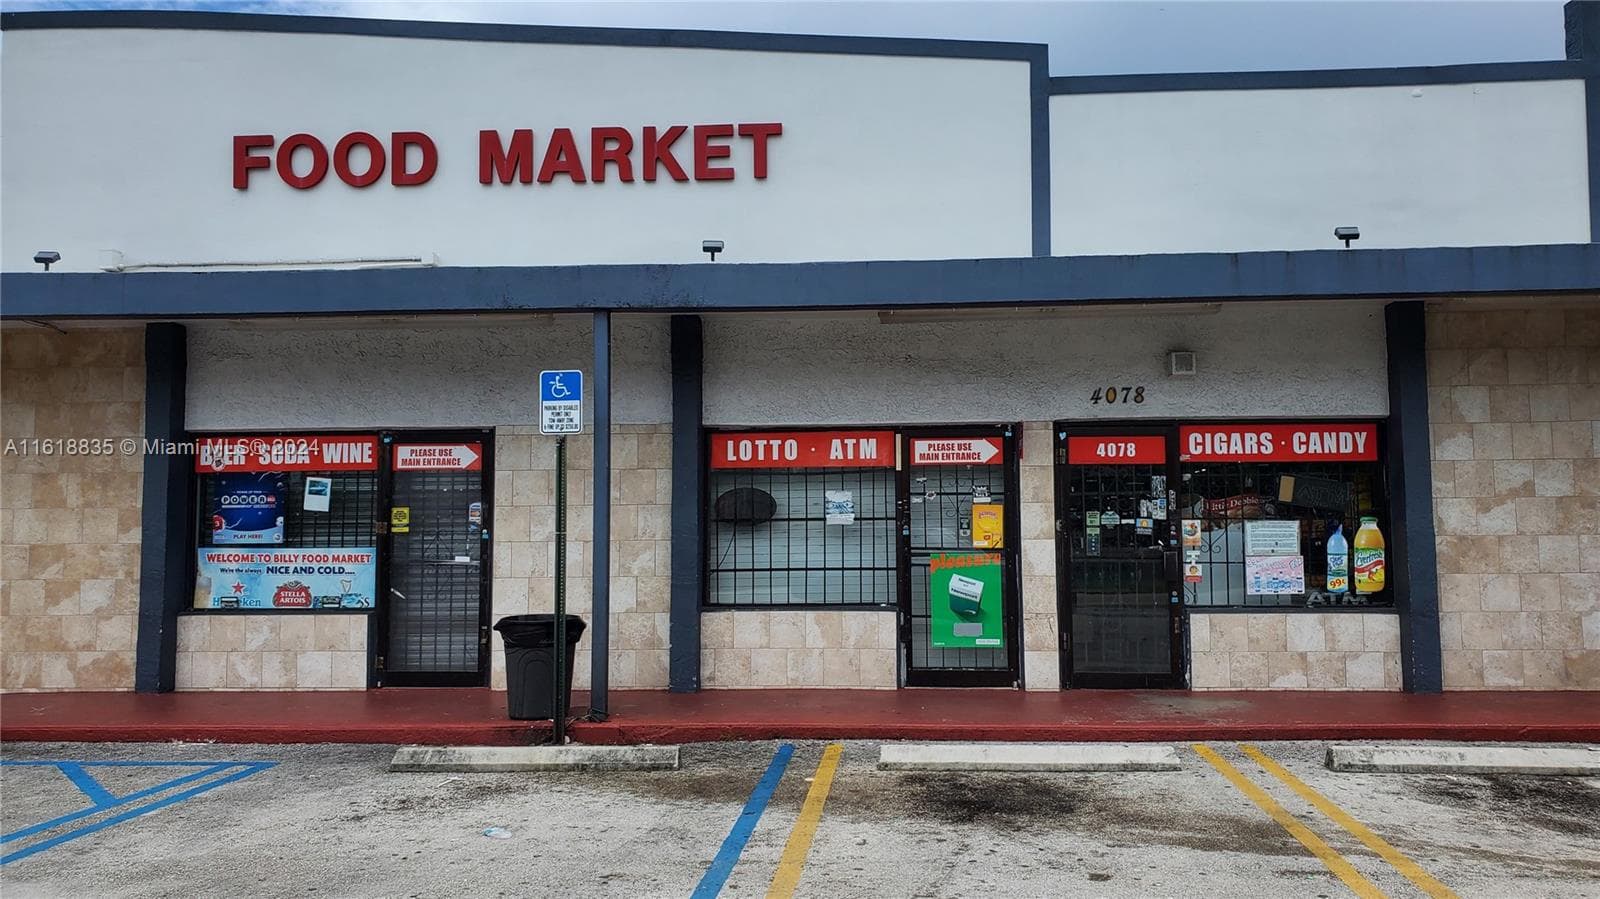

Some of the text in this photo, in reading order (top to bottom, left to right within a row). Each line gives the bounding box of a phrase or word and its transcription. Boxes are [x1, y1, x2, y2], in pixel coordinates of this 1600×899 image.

[232, 121, 783, 191] FOOD MARKET
[1090, 386, 1145, 404] 4078
[927, 443, 972, 452] PLEASE USE
[1188, 431, 1367, 455] CIGARS CANDY
[258, 443, 311, 465] SODA
[322, 442, 373, 464] WINE
[410, 448, 453, 457] PLEASE USE
[727, 438, 877, 461] LOTTO ATM
[1096, 443, 1136, 457] 4078
[401, 458, 461, 466] MAIN ENTRANCE
[919, 452, 981, 461] MAIN ENTRANCE
[207, 553, 371, 563] WELCOME TO BILLY FOOD MARKET
[266, 566, 290, 575] NICE
[292, 566, 315, 575] AND
[213, 596, 261, 607] Hken
